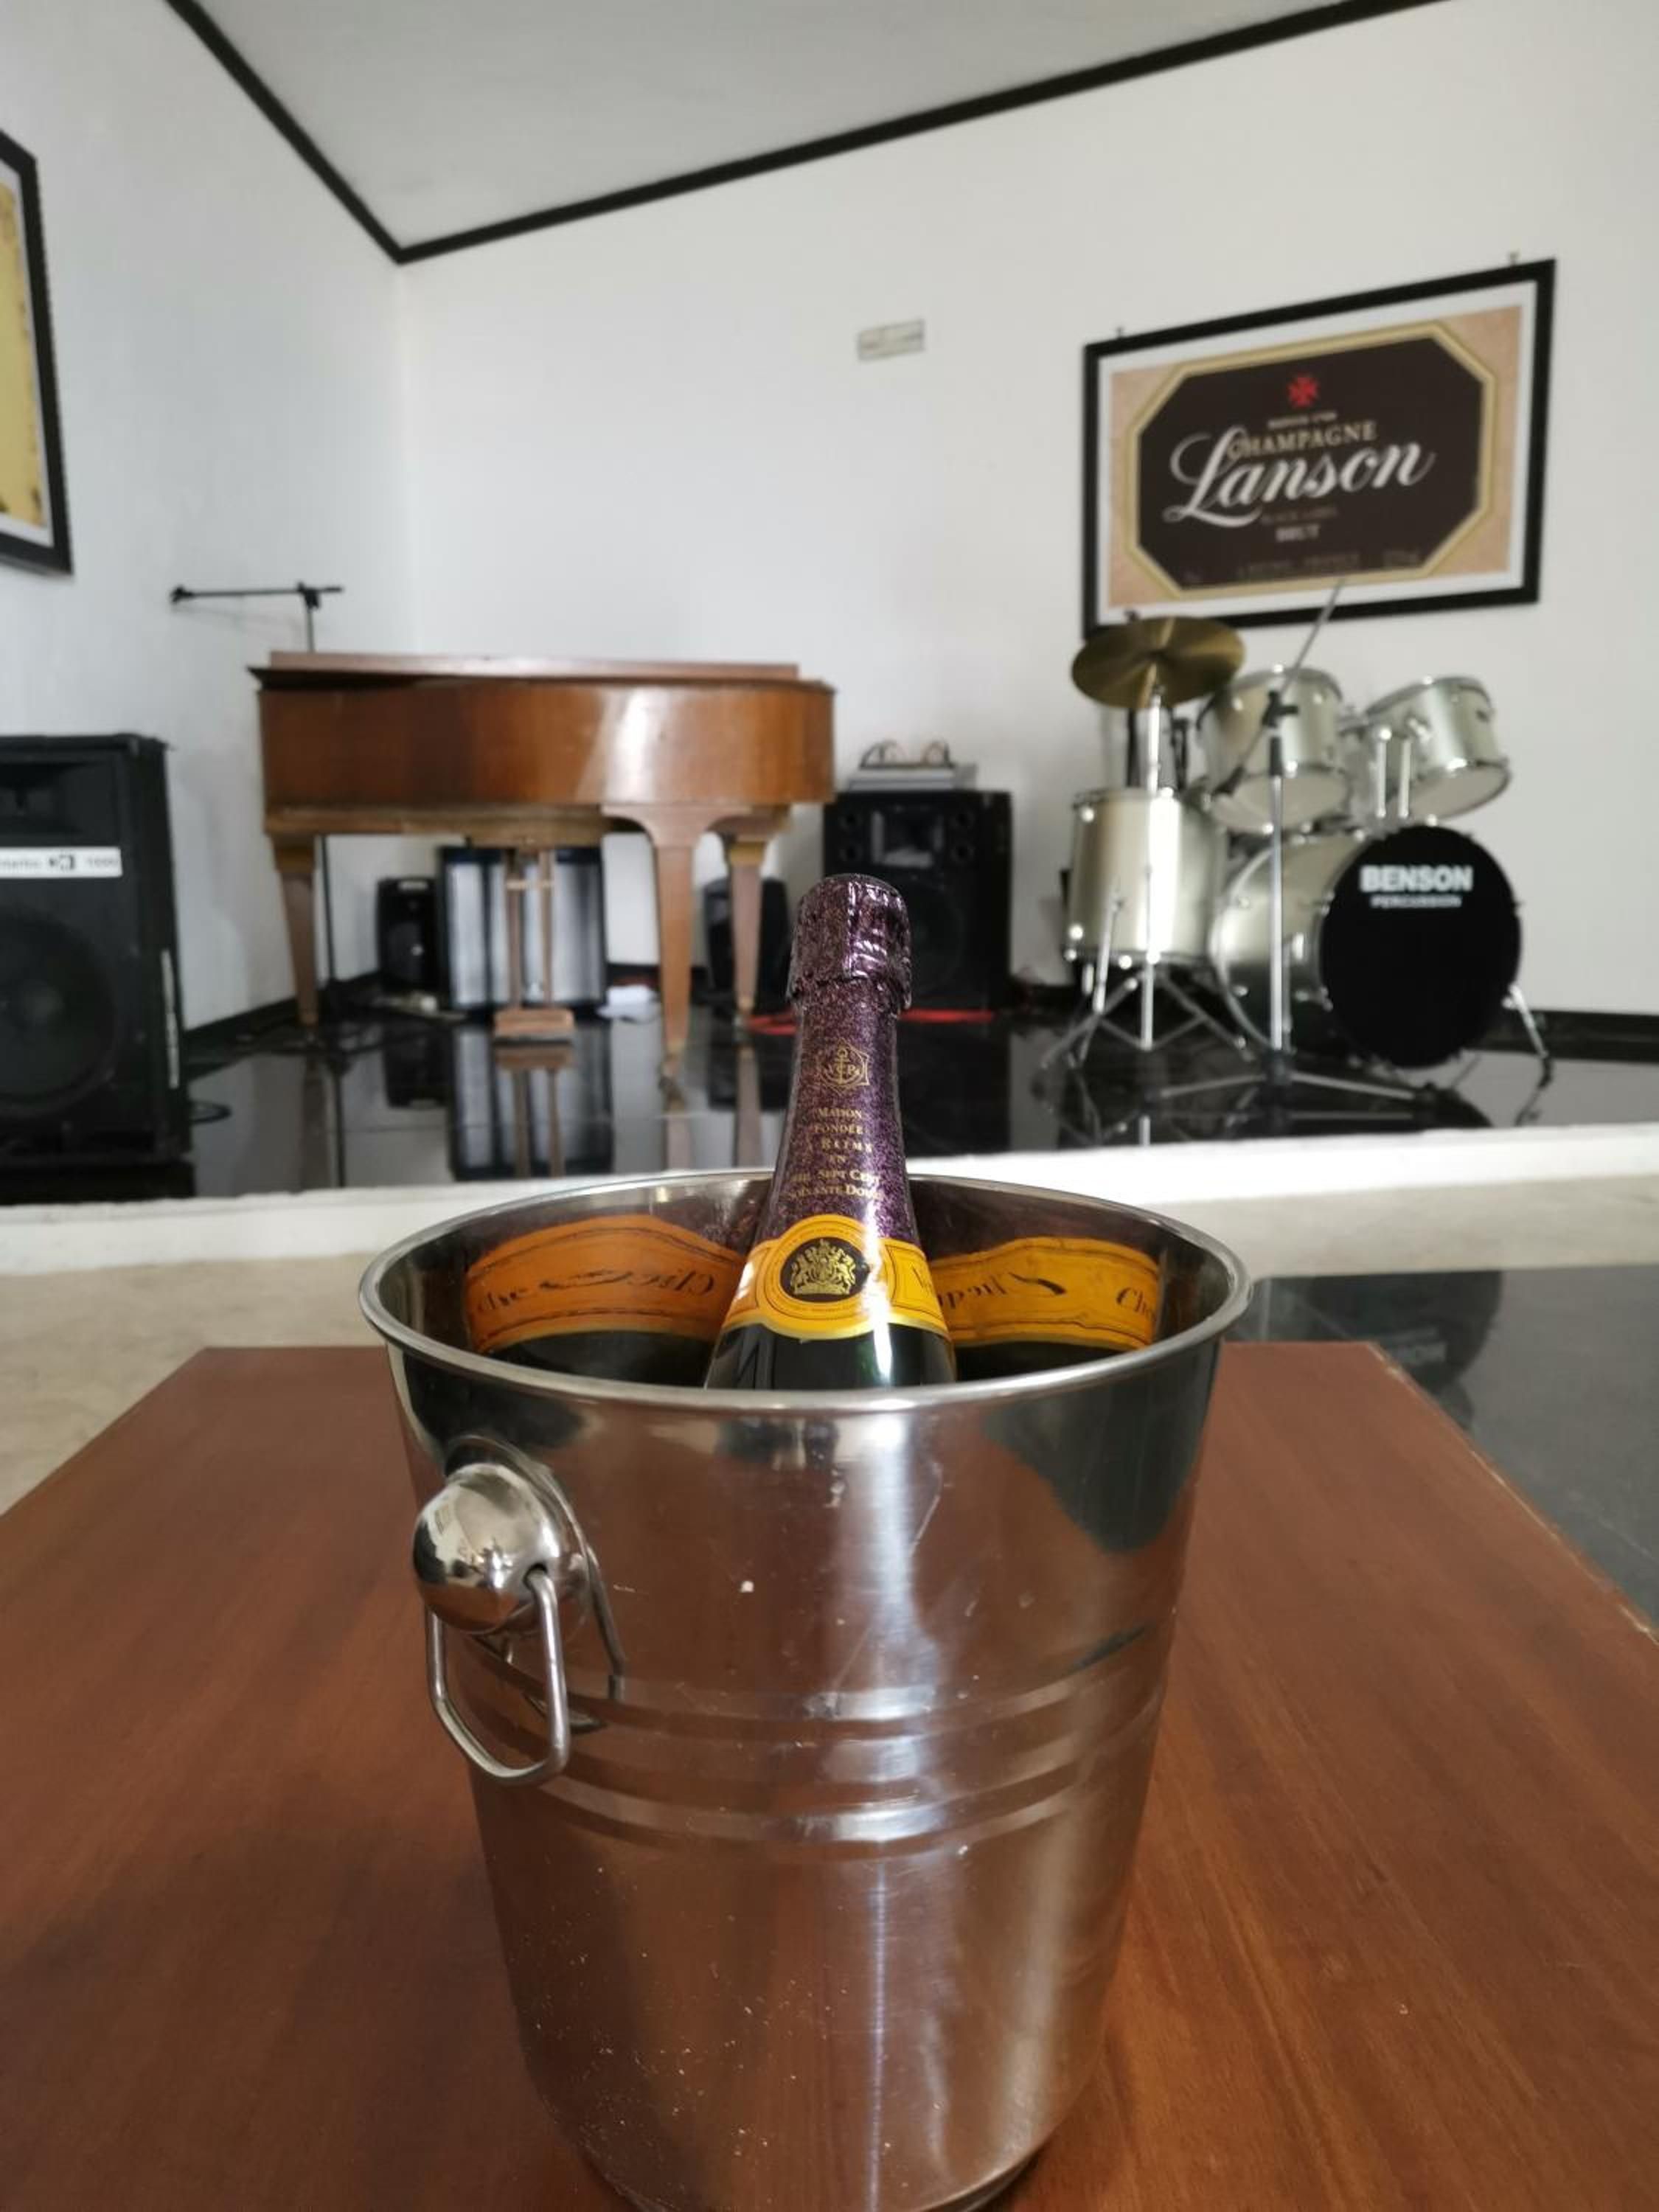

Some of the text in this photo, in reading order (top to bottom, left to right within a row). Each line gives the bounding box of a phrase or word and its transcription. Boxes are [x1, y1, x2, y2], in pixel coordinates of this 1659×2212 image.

[1226, 420, 1377, 459] CHAMPAGNE
[1163, 426, 1436, 528] Lanson
[1360, 864, 1473, 893] BENSON
